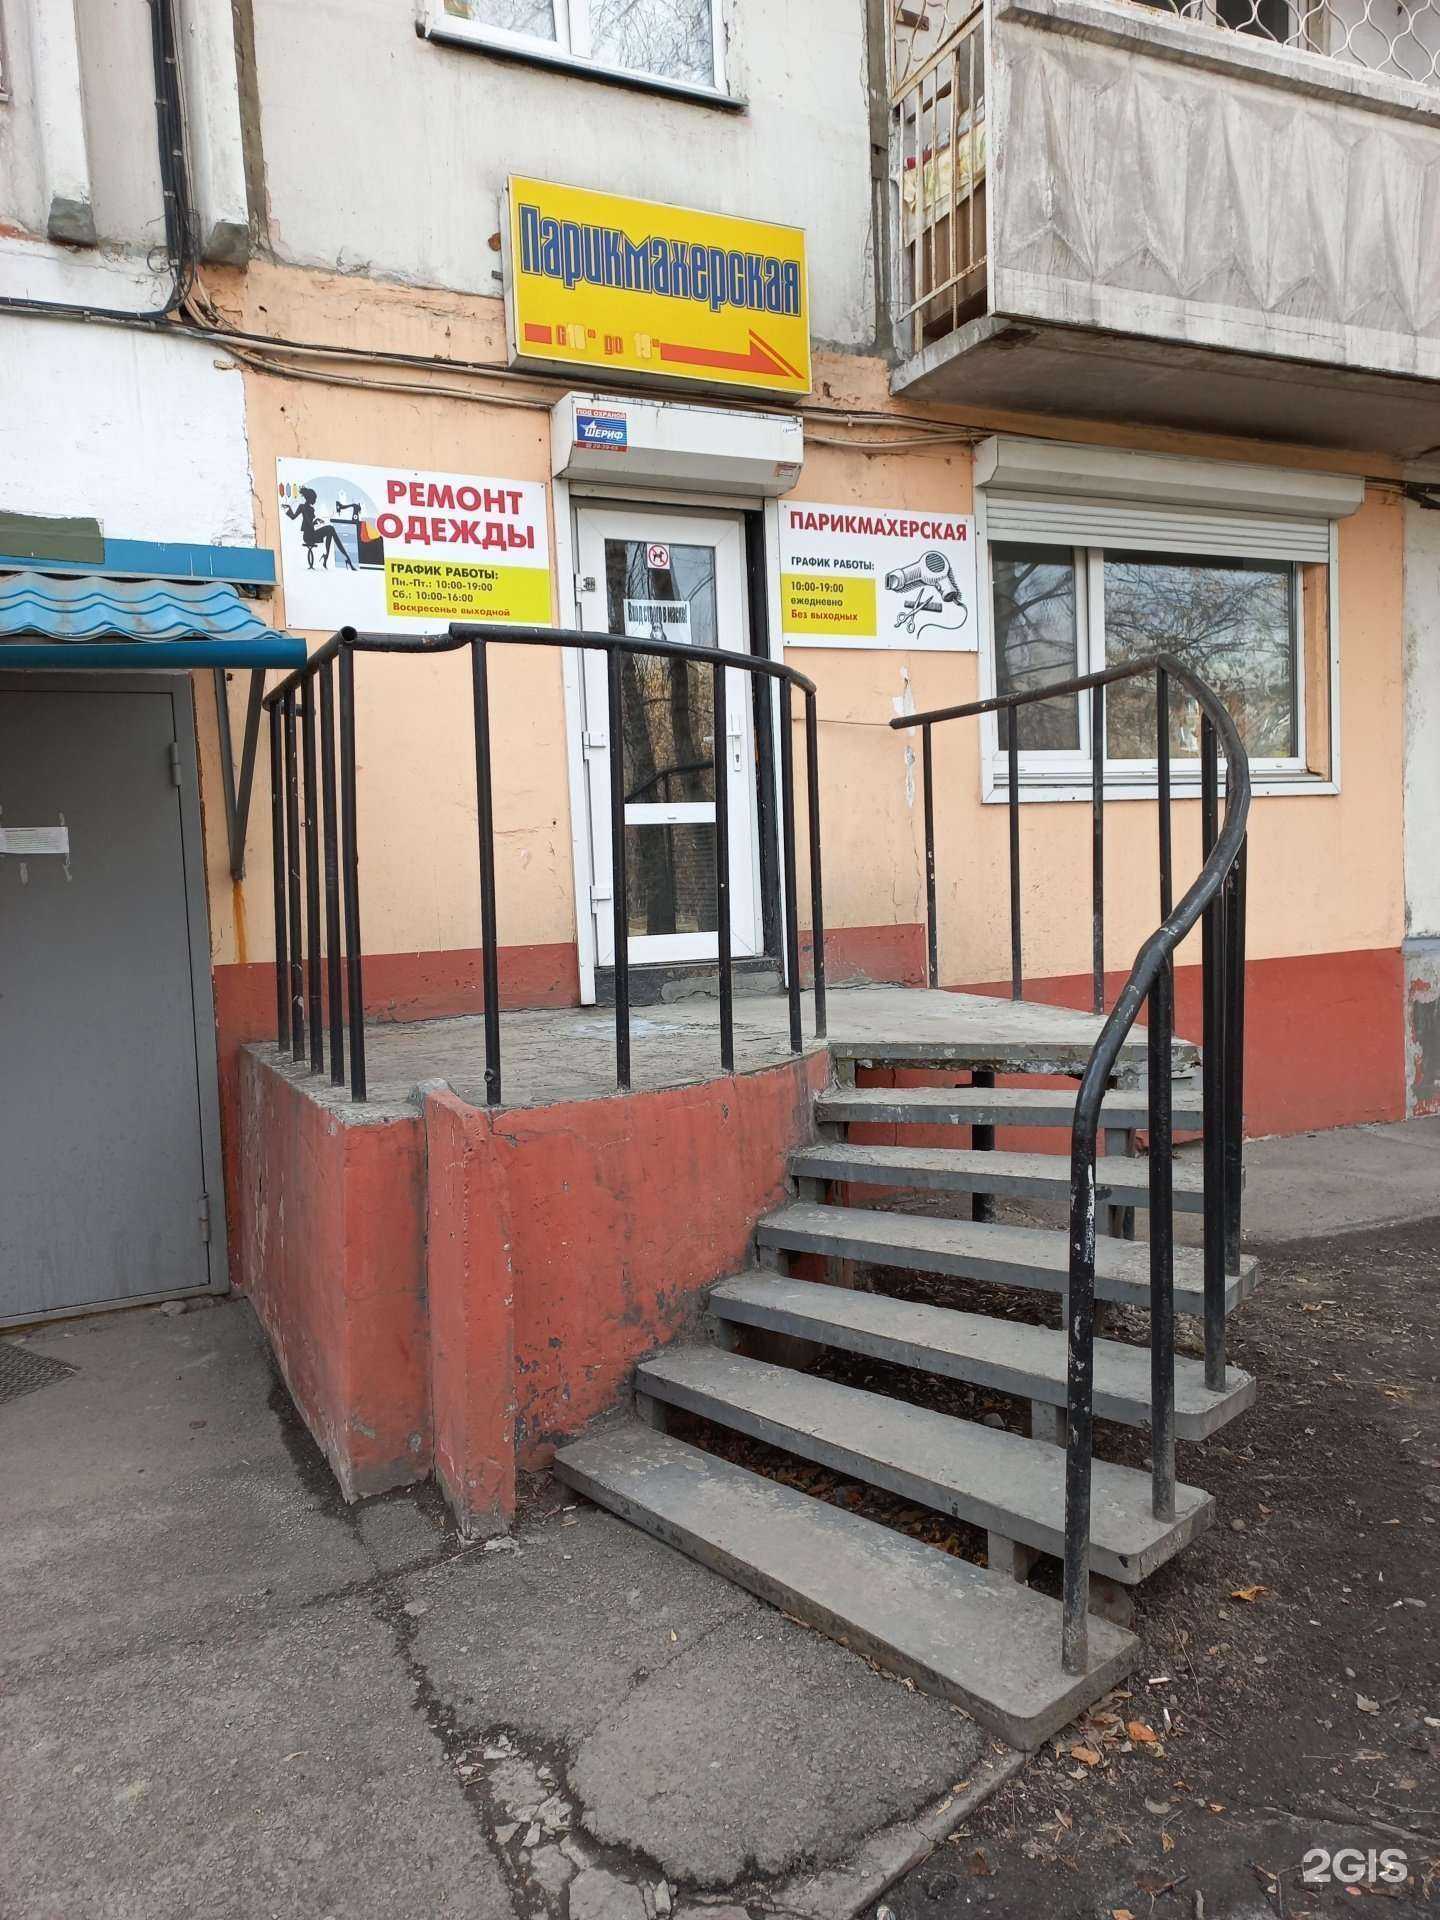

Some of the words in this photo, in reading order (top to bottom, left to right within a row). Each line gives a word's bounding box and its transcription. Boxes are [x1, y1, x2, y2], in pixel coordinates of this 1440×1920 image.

[518, 203, 801, 317] Парикмахерская
[584, 427, 624, 440] ШЕРИФ
[386, 479, 523, 515] РЕМОНТ
[376, 512, 535, 551] ОДЕЖДЫ
[789, 510, 967, 541] ПАРИКМАХЕРСКАЯ
[791, 556, 831, 568] ГРАФИК
[833, 558, 875, 570] РАБОТЫ:
[390, 562, 441, 577] ГРАФИК
[445, 566, 499, 580] РАБОТЫ:
[391, 578, 432, 590] Пн.-Пт.:
[436, 580, 493, 592] 10:00-19:00
[790, 581, 844, 593] 10:00-19:00
[392, 589, 412, 600] Сб.:
[416, 591, 474, 603] 10:00-16:00
[790, 597, 843, 607] ежедневно
[392, 602, 458, 614] Воскресенье
[461, 607, 511, 617] выходной
[791, 609, 808, 620] Без
[810, 612, 858, 622] выходных
